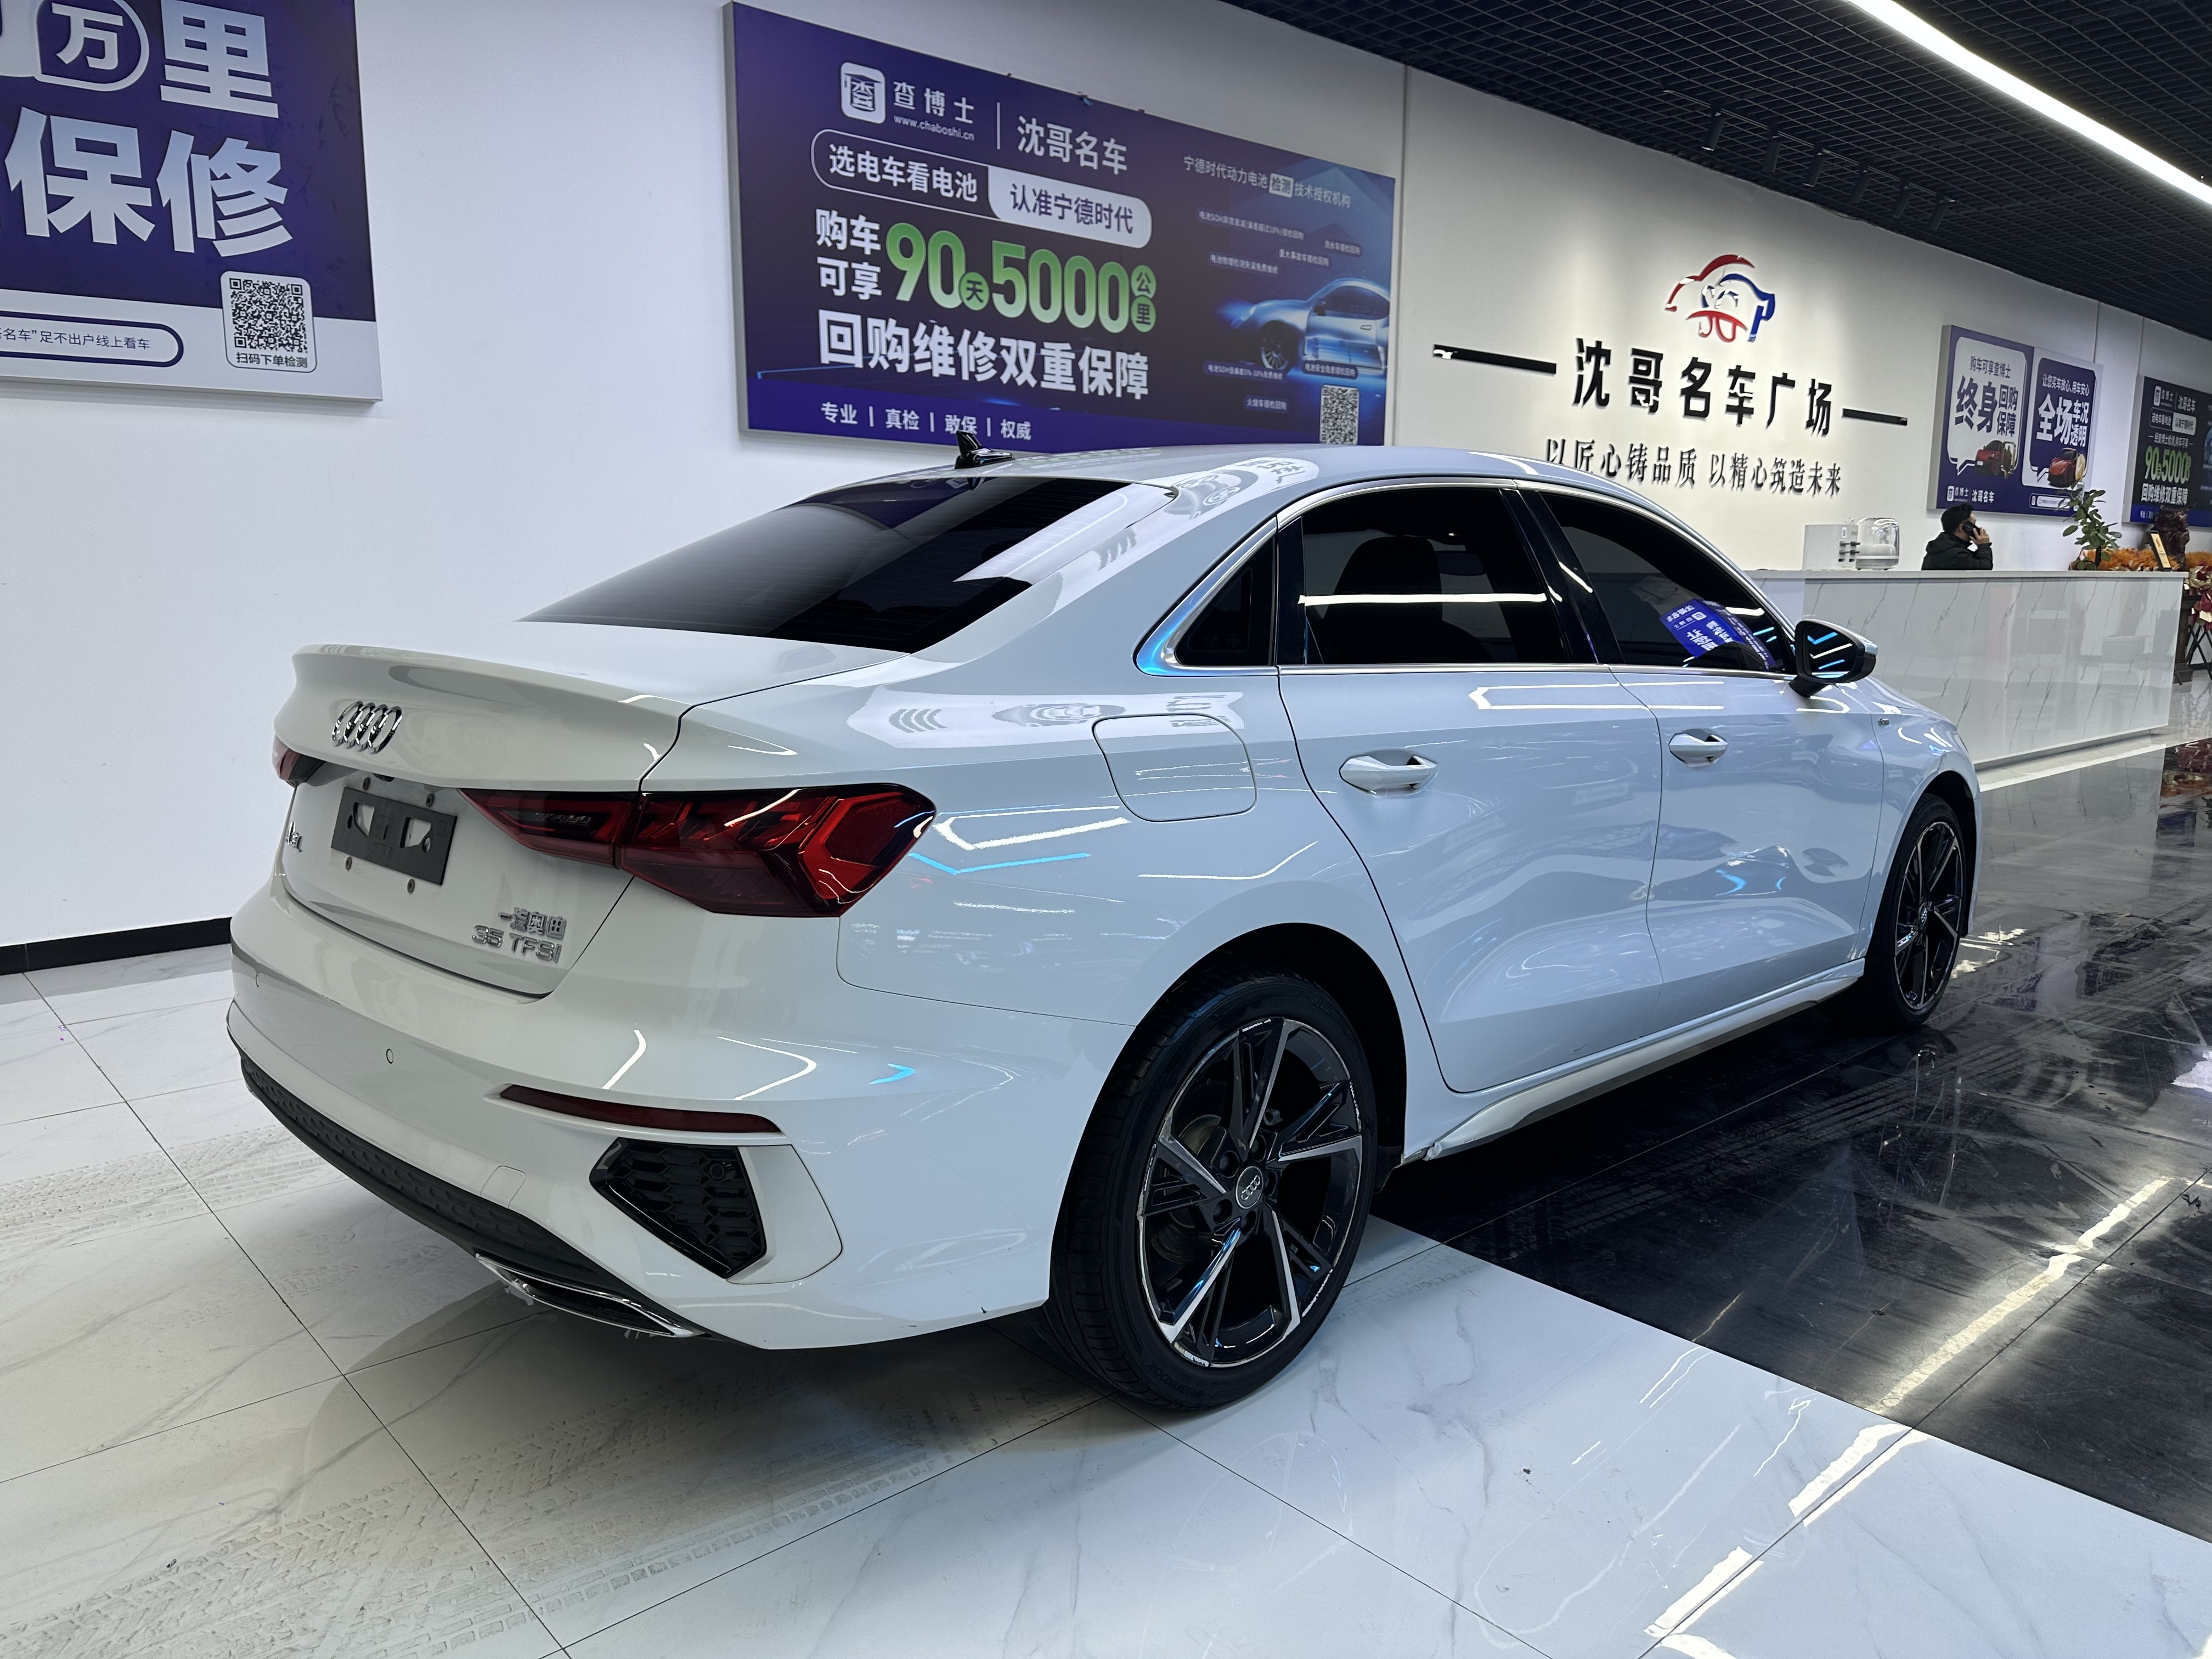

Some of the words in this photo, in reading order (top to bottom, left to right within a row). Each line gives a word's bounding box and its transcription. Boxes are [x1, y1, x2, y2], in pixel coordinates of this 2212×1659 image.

[893, 80, 975, 124] 查博士
[1017, 115, 1127, 175] 沈哥名车
[894, 114, 975, 141] www.chaboshi.cn
[4, 106, 293, 257] 保修
[828, 143, 978, 202] 选电车看电池
[1010, 183, 1133, 234] 认准宁德时代
[815, 208, 882, 255] 购车
[816, 257, 882, 300] 可享
[0, 328, 150, 350] 名车”足不出户线上看车
[819, 309, 1149, 400] 回购维修双重保障
[236, 352, 308, 368] 扫码下单检测
[1969, 356, 2011, 379] 购车可享查博士
[1572, 337, 1832, 437] 沈哥名车广场
[1955, 375, 1998, 433] 终身
[1999, 383, 2019, 411] 回购
[821, 402, 857, 425] 专业
[885, 409, 920, 431] 真检
[945, 414, 978, 435] 敢保
[1001, 419, 1031, 441] 权威
[1996, 410, 2017, 437] 保障
[2036, 393, 2073, 445] 全场
[2073, 399, 2090, 424] 车况
[2070, 424, 2087, 448] 透明
[1545, 438, 1697, 489] 以匠心铸品质
[1709, 453, 1842, 496] 以精心筑造未来
[1972, 489, 1995, 503] 沈哥名车
[2141, 483, 2189, 506] 回购维修双重保障
[471, 924, 505, 948] 35
[509, 932, 562, 963] TFSI
